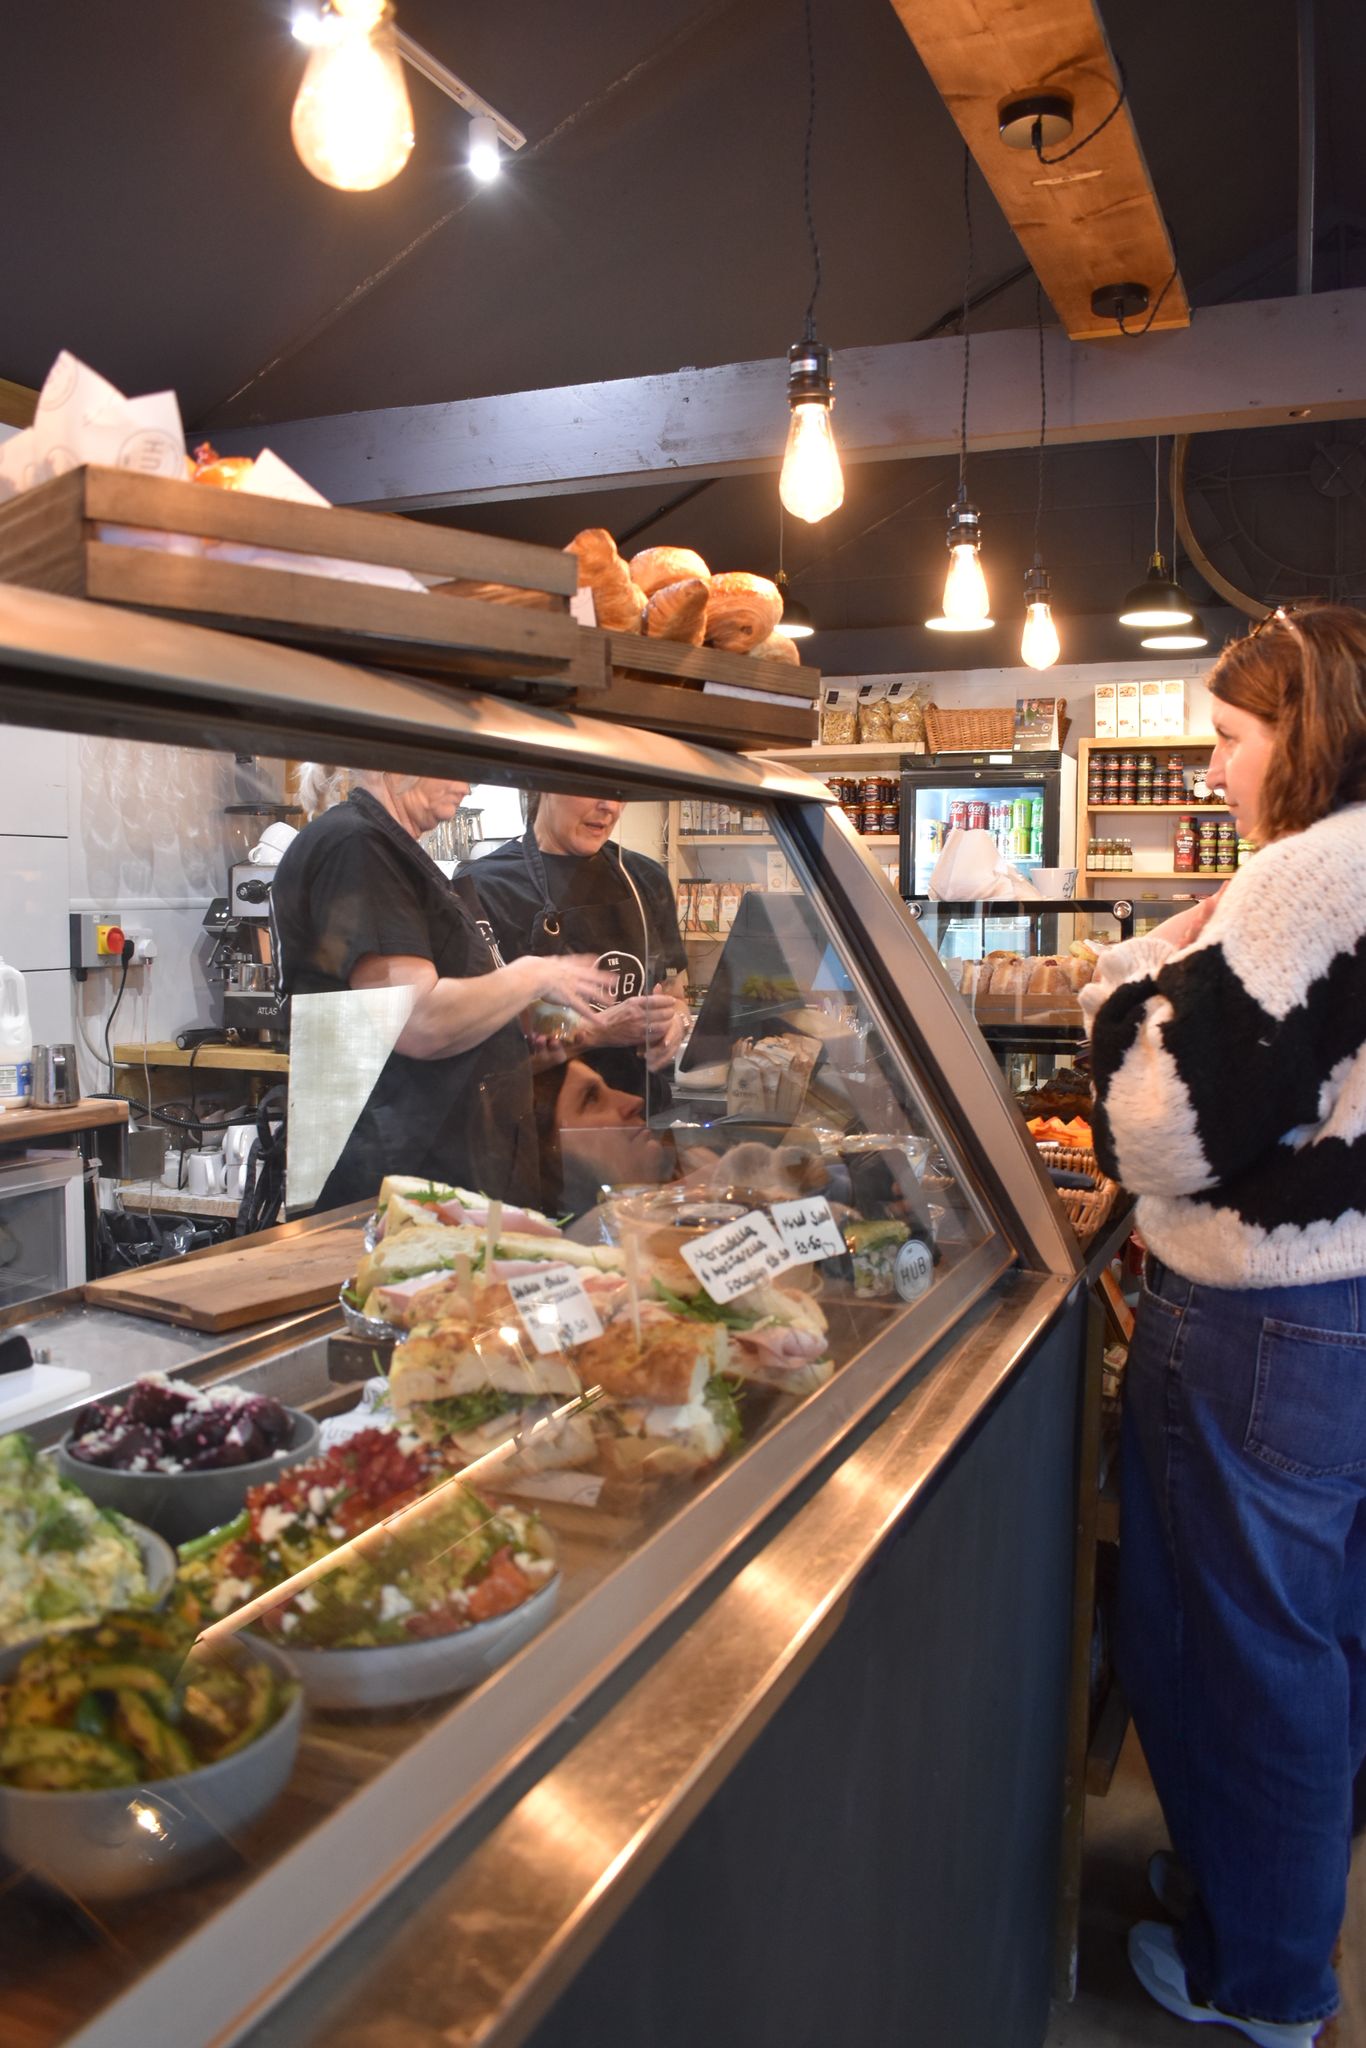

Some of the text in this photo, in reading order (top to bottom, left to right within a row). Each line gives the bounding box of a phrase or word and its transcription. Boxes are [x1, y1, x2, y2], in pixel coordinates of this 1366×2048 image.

[607, 957, 621, 966] THE
[257, 1006, 278, 1016] ATLAS
[900, 1256, 927, 1286] HUB
